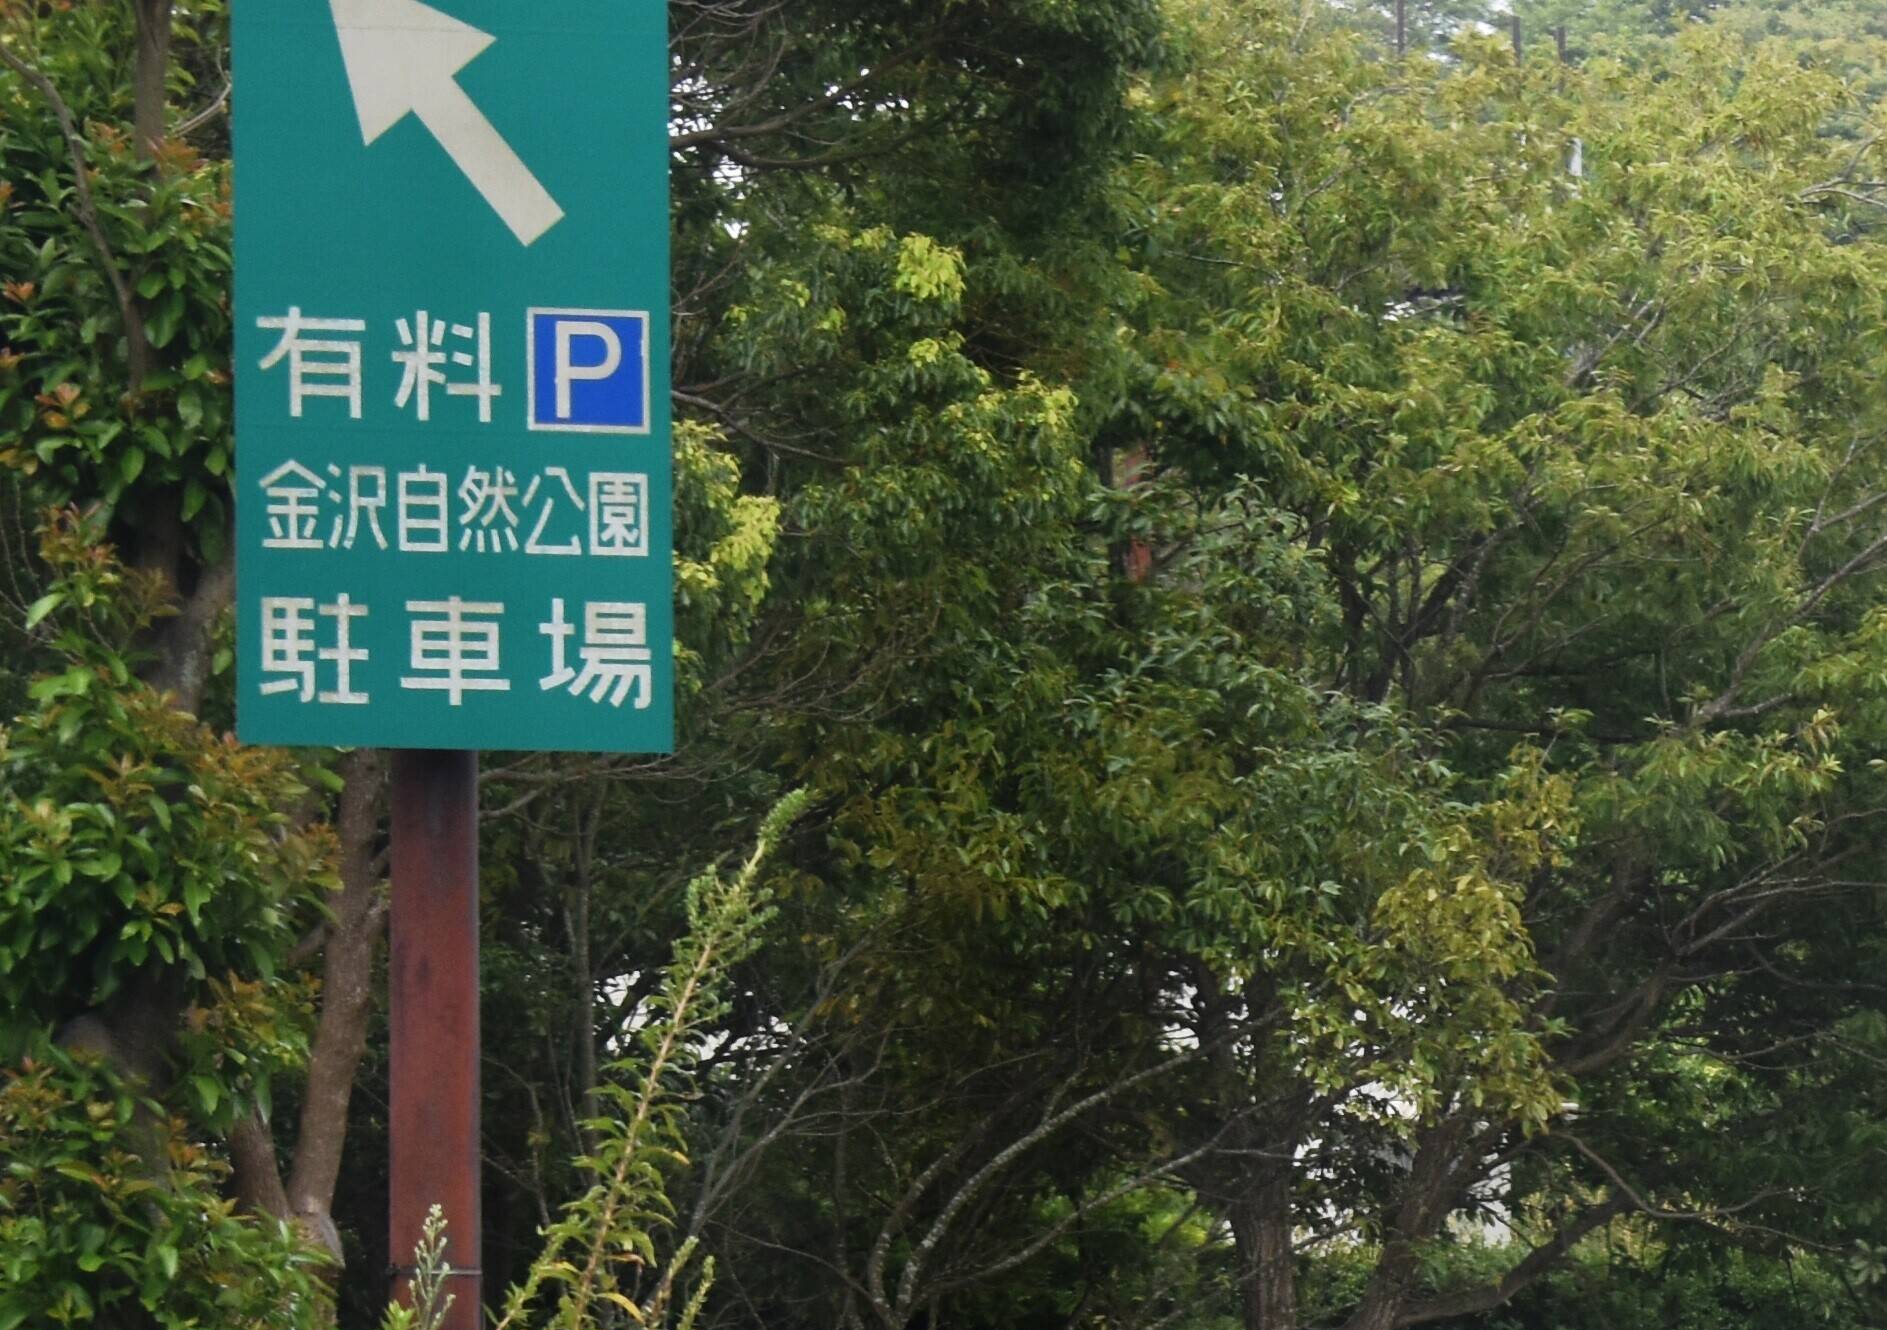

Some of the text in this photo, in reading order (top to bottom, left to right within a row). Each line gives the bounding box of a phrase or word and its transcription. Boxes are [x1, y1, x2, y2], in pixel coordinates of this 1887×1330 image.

[256, 306, 622, 423] 有料 P
[258, 459, 649, 557] 金沢自然公園
[259, 593, 652, 710] 駐車場
